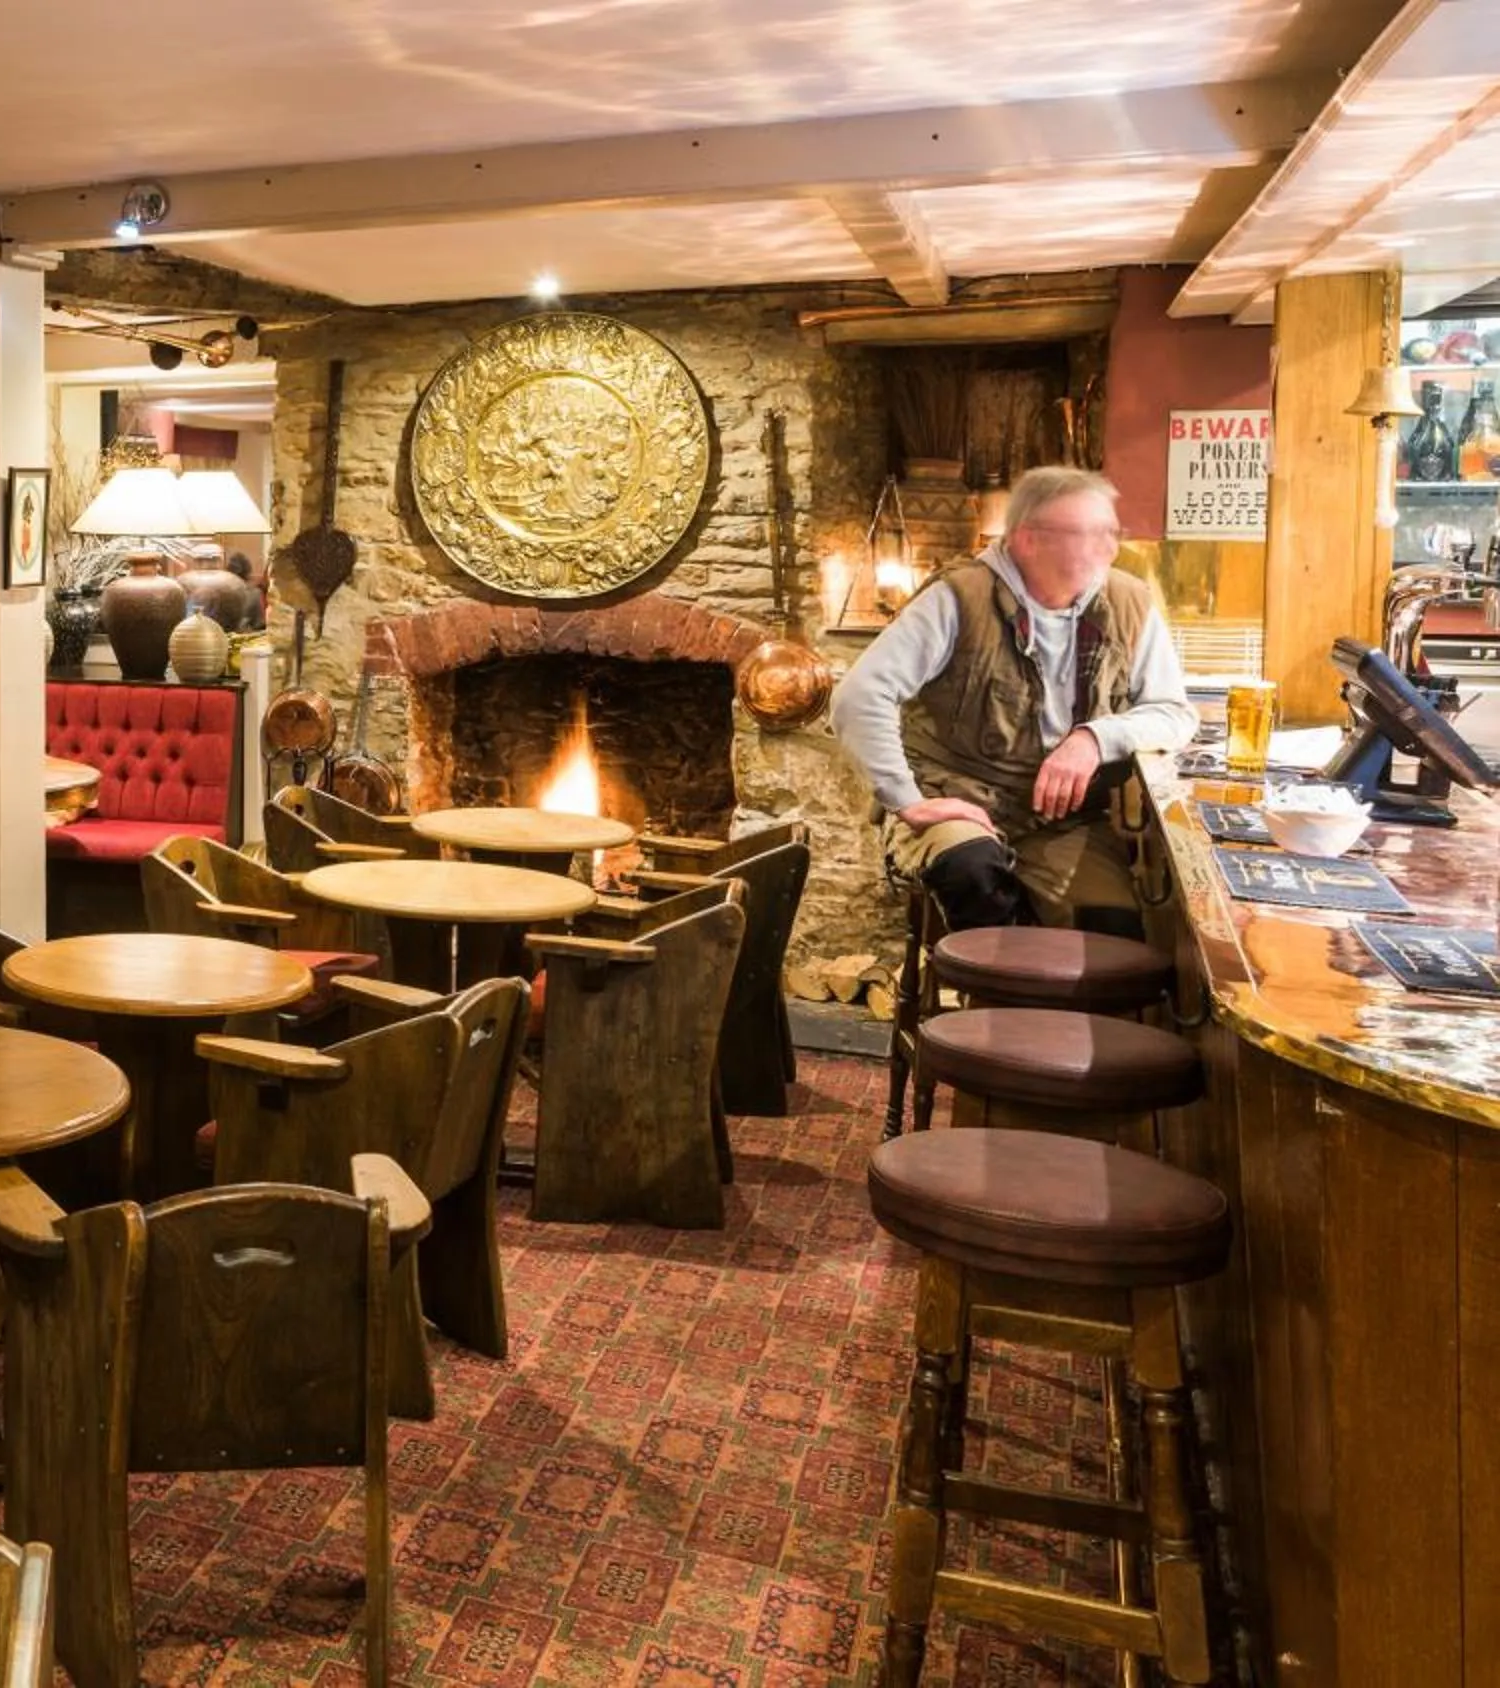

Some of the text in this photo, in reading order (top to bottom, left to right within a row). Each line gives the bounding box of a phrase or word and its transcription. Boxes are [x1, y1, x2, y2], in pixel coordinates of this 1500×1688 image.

[1171, 417, 1271, 440] BEWAR
[1200, 441, 1261, 460] POKER
[1186, 491, 1267, 508] LOOSE
[1173, 508, 1267, 526] WOME
